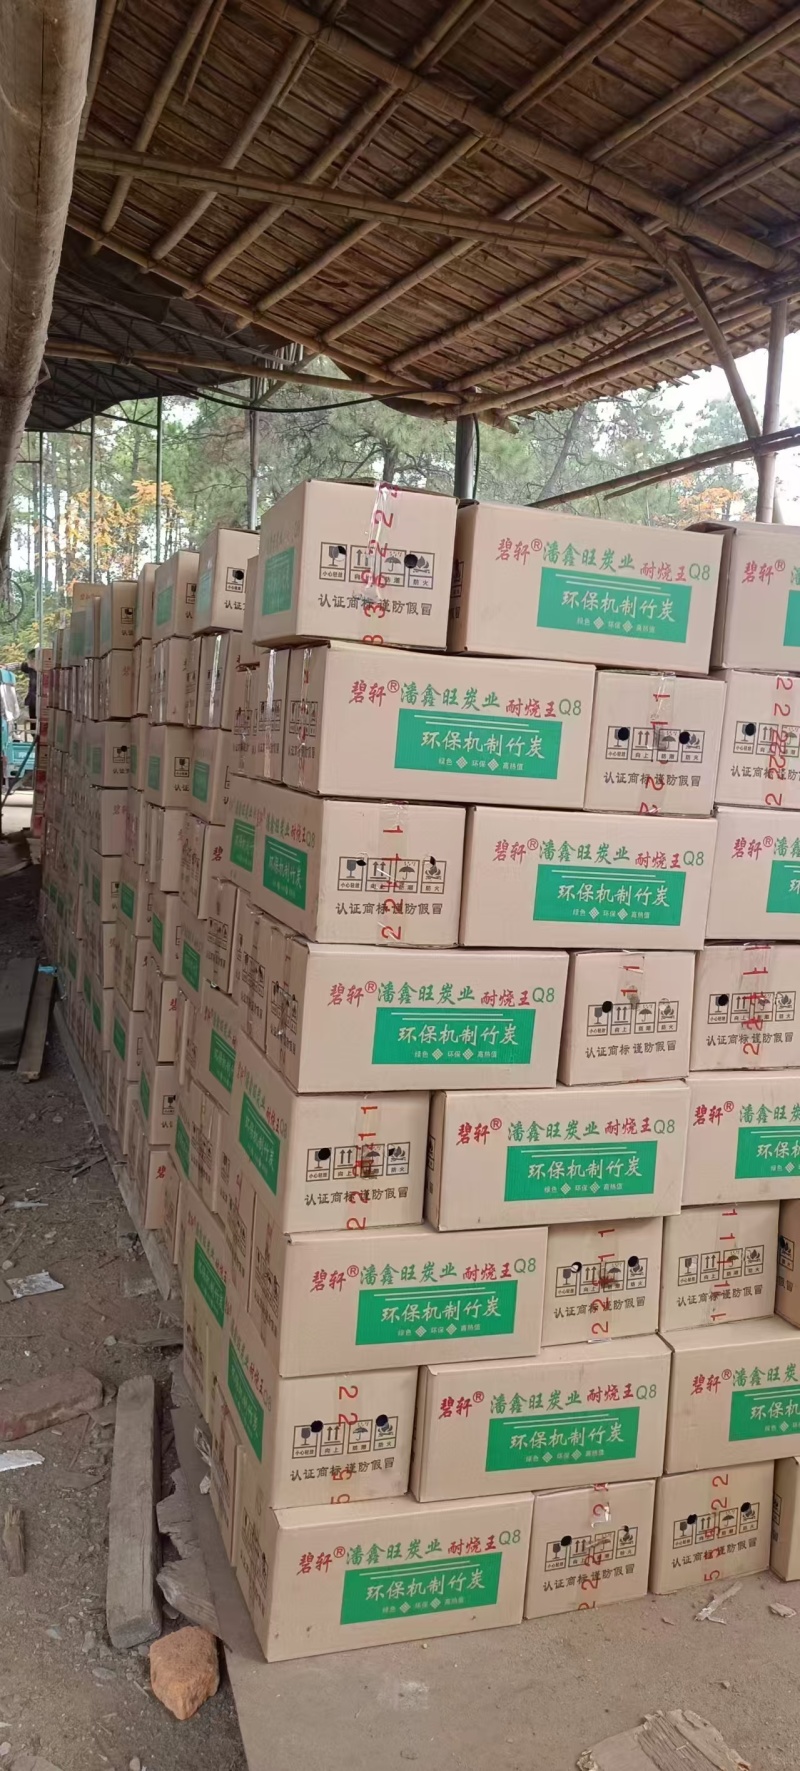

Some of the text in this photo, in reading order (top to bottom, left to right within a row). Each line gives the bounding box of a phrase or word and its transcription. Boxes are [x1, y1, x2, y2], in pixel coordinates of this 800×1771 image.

[561, 591, 675, 622] 环保机制竹炭
[421, 730, 545, 759] 环保机制竹炭
[604, 771, 701, 786] 认证商标谨防假冒
[558, 883, 670, 907] 环保机制竹炭
[336, 902, 443, 915] 认证商标谨防假冒
[398, 1023, 518, 1046] 环保机制竹炭
[706, 1032, 793, 1046] 认证商标谨防假冒
[585, 1040, 676, 1058] 认证商标谨防假冒
[528, 1155, 642, 1180] 环保机制竹炭
[304, 1186, 408, 1206] 认证商标谨防假冒
[381, 1297, 502, 1323] 环保机制竹炭
[509, 1422, 624, 1450] 环保机制竹炭
[290, 1457, 394, 1481] 认证商标谨防假冒
[366, 1568, 485, 1602] 环保机制竹炭
[543, 1564, 634, 1592] 认证商标谨防假冒
